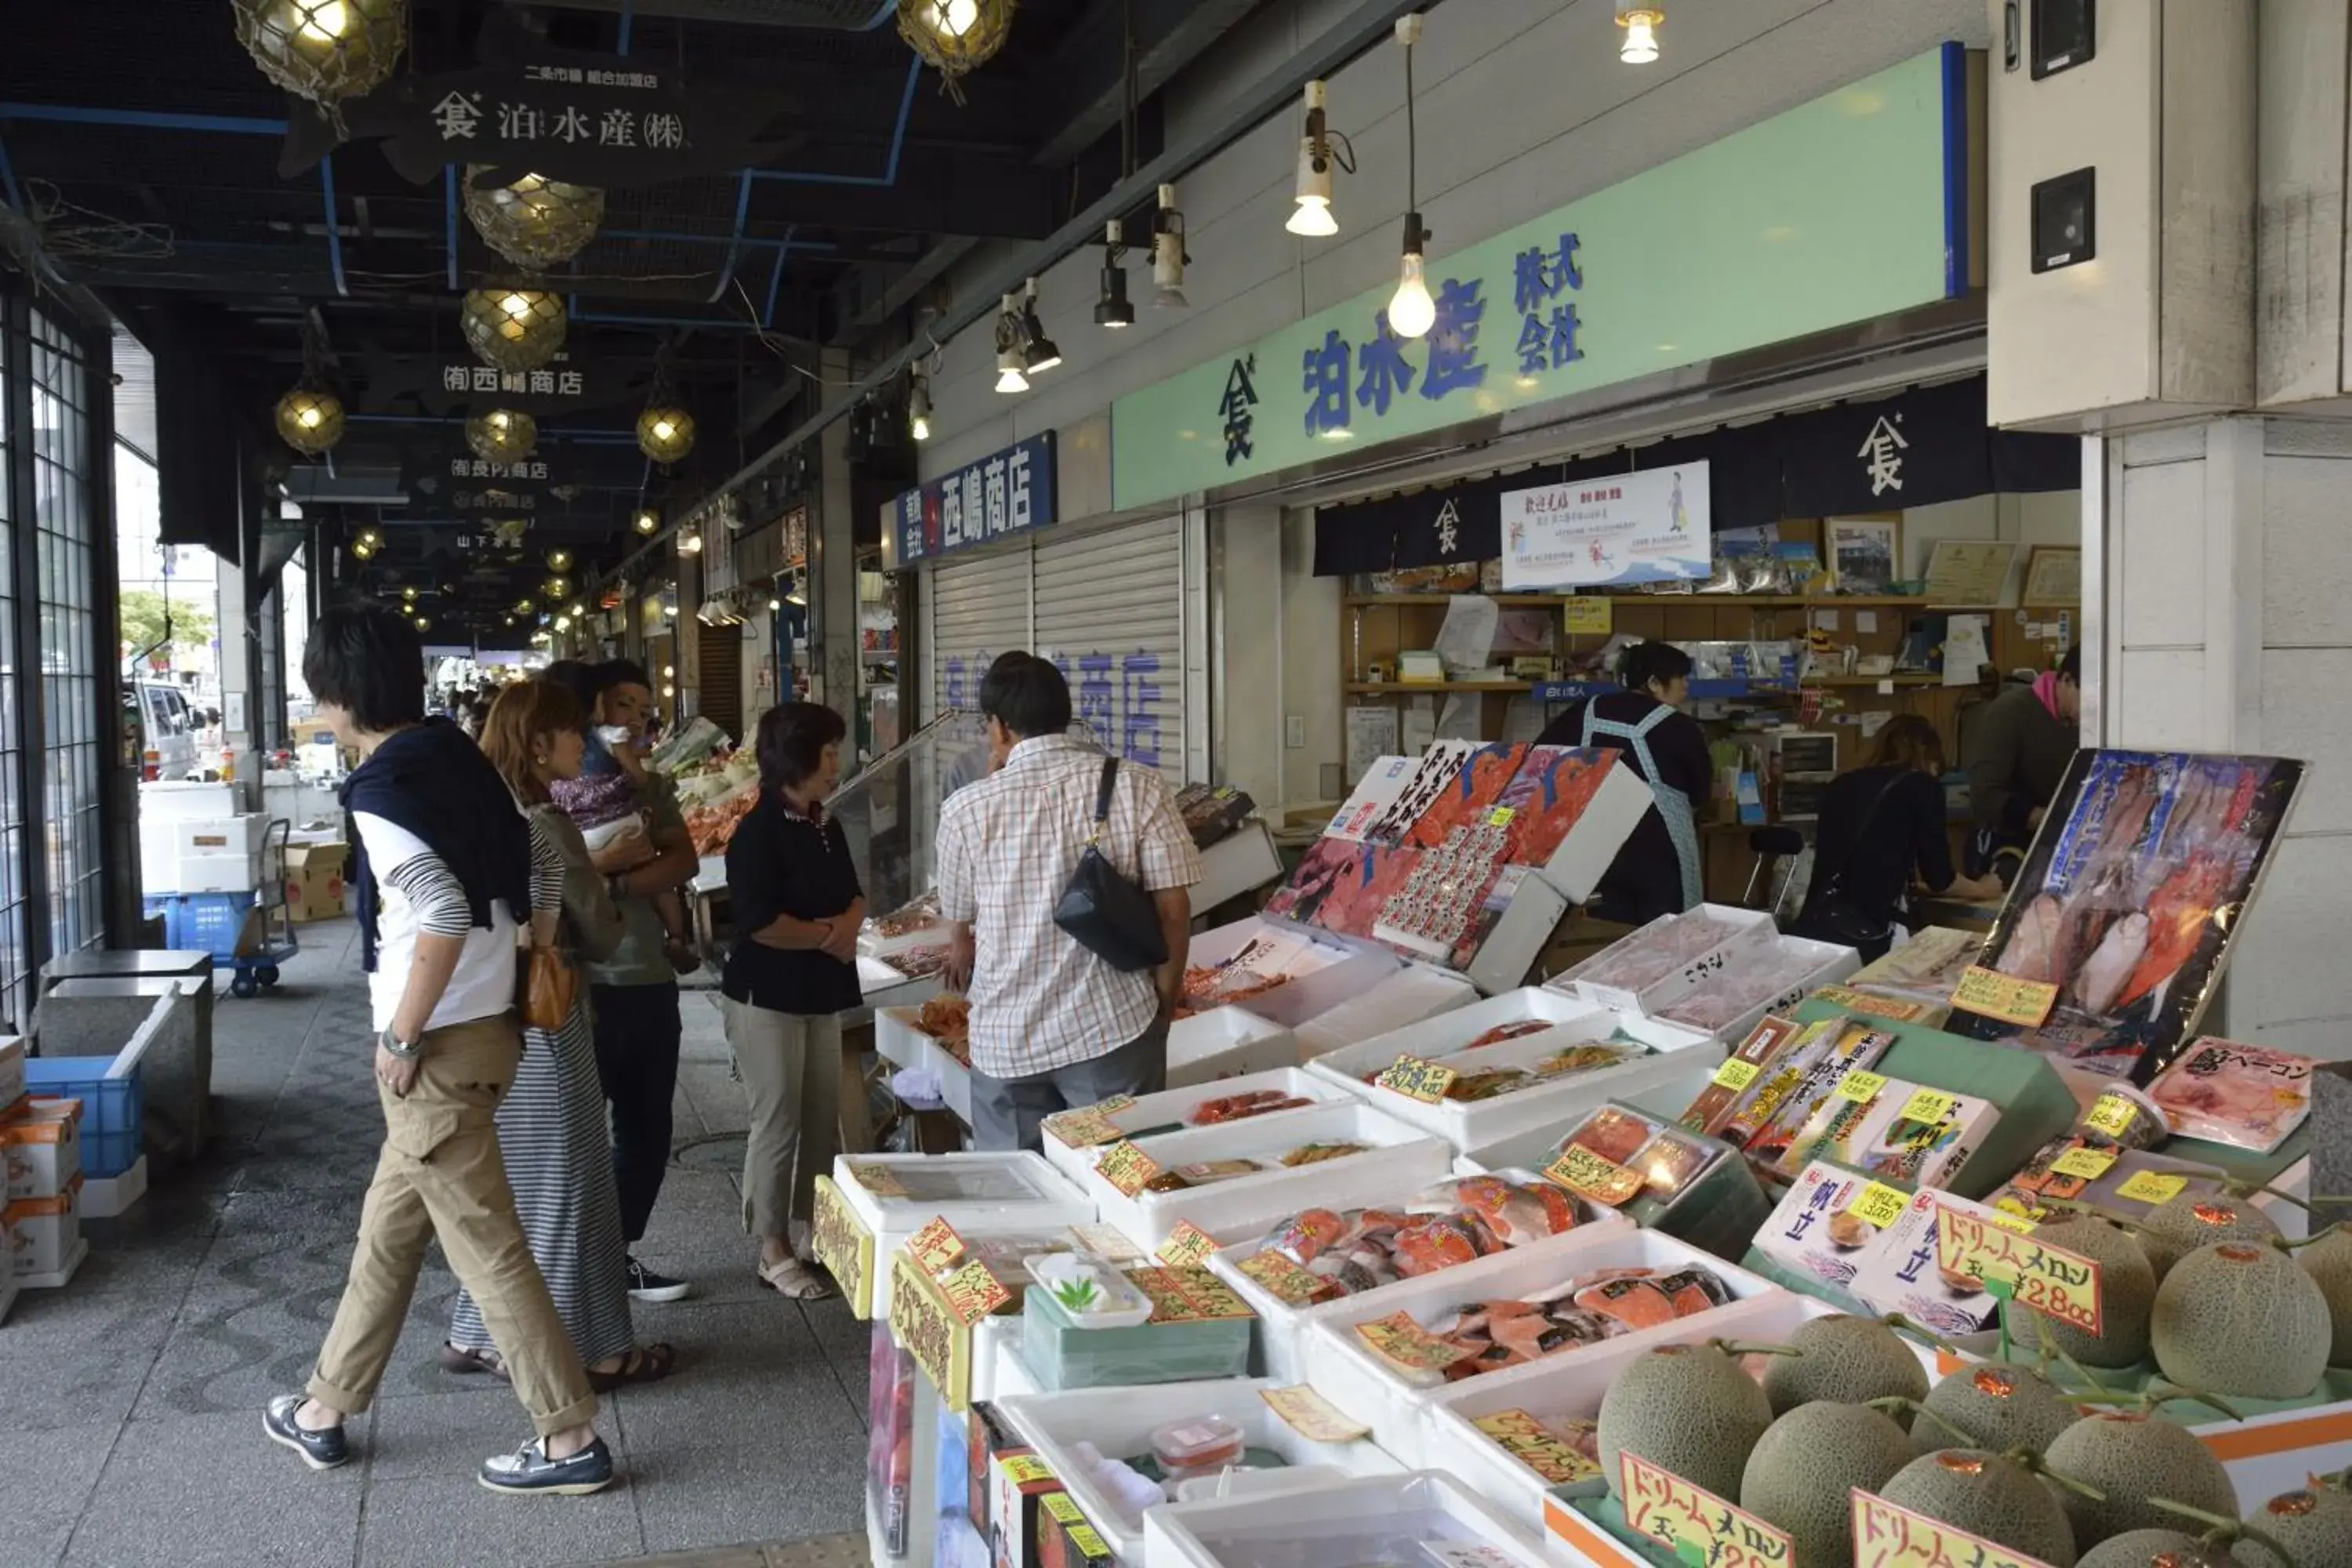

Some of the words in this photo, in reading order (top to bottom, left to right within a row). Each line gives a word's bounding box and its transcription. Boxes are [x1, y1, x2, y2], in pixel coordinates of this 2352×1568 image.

[1304, 278, 1488, 439] 泊水産
[1784, 1178, 1838, 1241] 帆立
[2009, 1272, 2096, 1325] ¥2800
